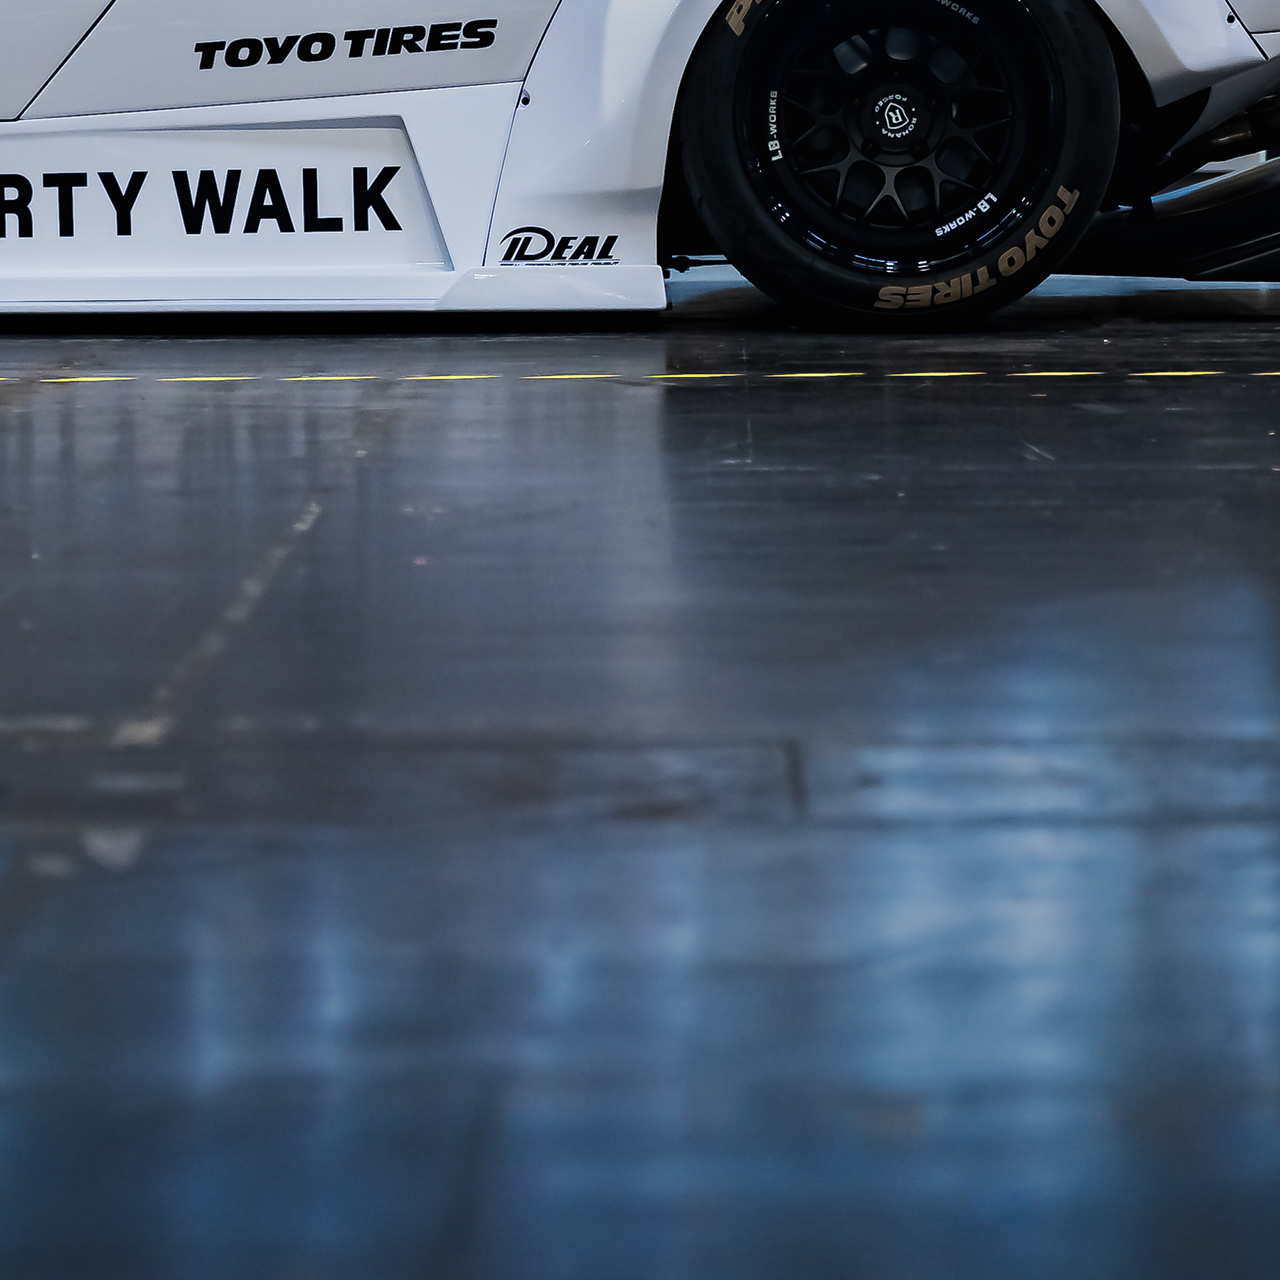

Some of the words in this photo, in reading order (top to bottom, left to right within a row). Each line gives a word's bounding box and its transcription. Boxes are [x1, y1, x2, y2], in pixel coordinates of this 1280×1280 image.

[194, 32, 336, 70] TOYO
[343, 19, 498, 59] TIRES
[768, 90, 784, 161] LB-WORKS
[881, 117, 917, 138] ROHANA
[172, 166, 403, 235] WALK
[935, 192, 998, 237] LB-WORKS
[499, 226, 619, 261] IDEAL
[997, 185, 1080, 273] TOYO
[874, 269, 997, 309] TIRES
